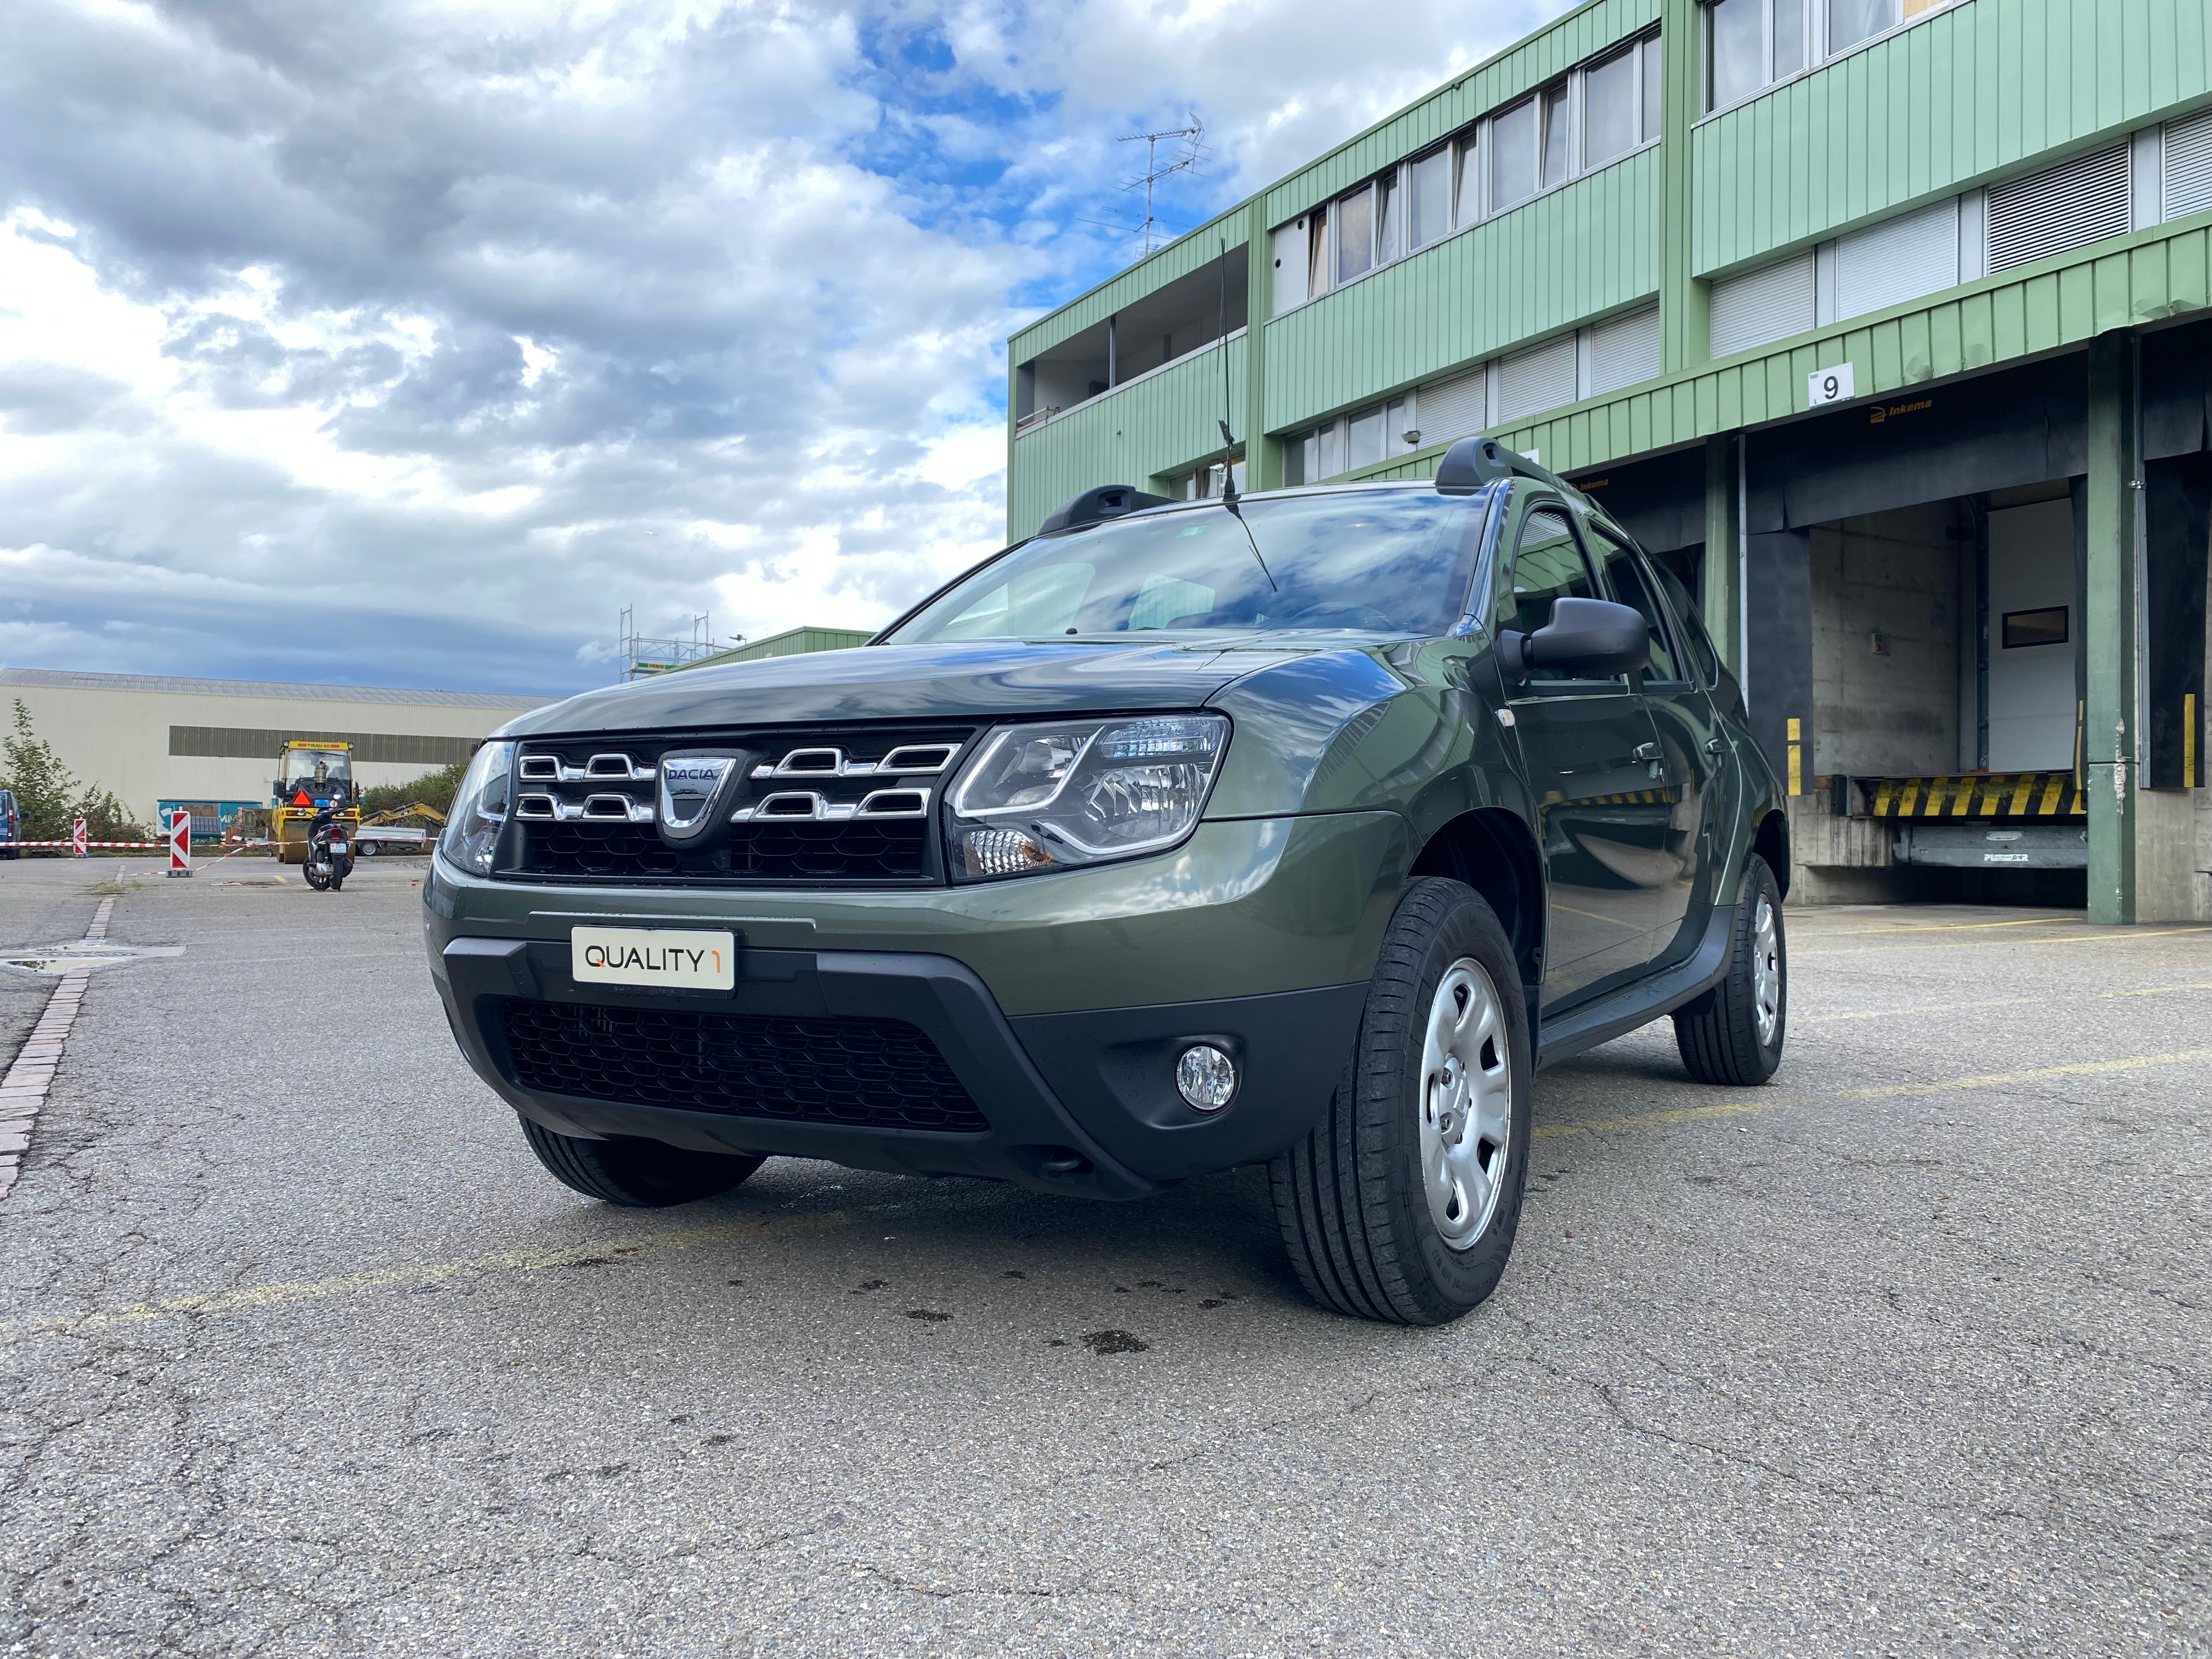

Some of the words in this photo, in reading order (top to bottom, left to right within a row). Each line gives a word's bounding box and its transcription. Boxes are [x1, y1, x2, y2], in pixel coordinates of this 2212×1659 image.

[1824, 376, 1838, 399] 9
[1889, 400, 1932, 416] Inkema
[1581, 479, 1609, 491] Inkema
[667, 769, 715, 780] DACIA
[585, 945, 705, 972] QUALITY
[712, 950, 720, 973] 1
